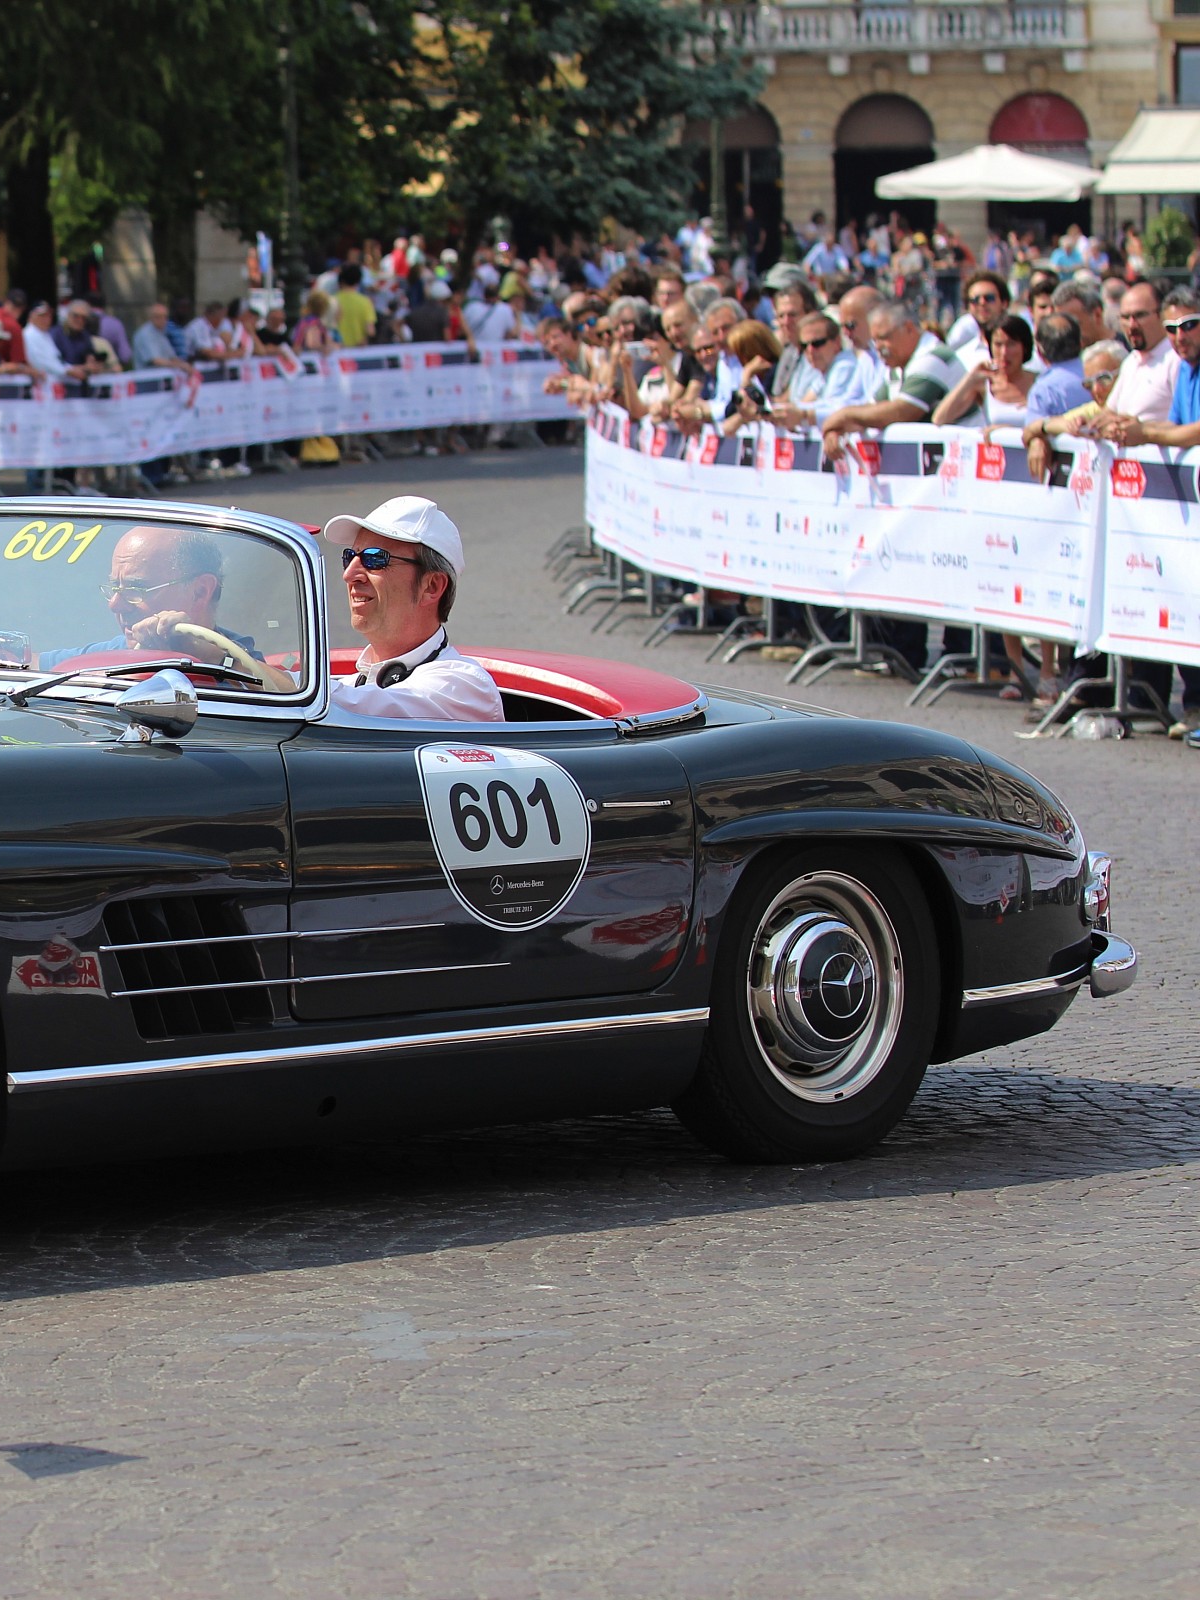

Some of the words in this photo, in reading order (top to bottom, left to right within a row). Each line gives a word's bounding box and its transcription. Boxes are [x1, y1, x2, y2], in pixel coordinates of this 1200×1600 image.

[1117, 461, 1139, 478] 1000
[3, 520, 103, 564] 601
[932, 551, 968, 570] CHOPARD
[449, 778, 561, 852] 601
[506, 880, 545, 889] Mercedes-Benz
[503, 906, 522, 914] TRIBUTE
